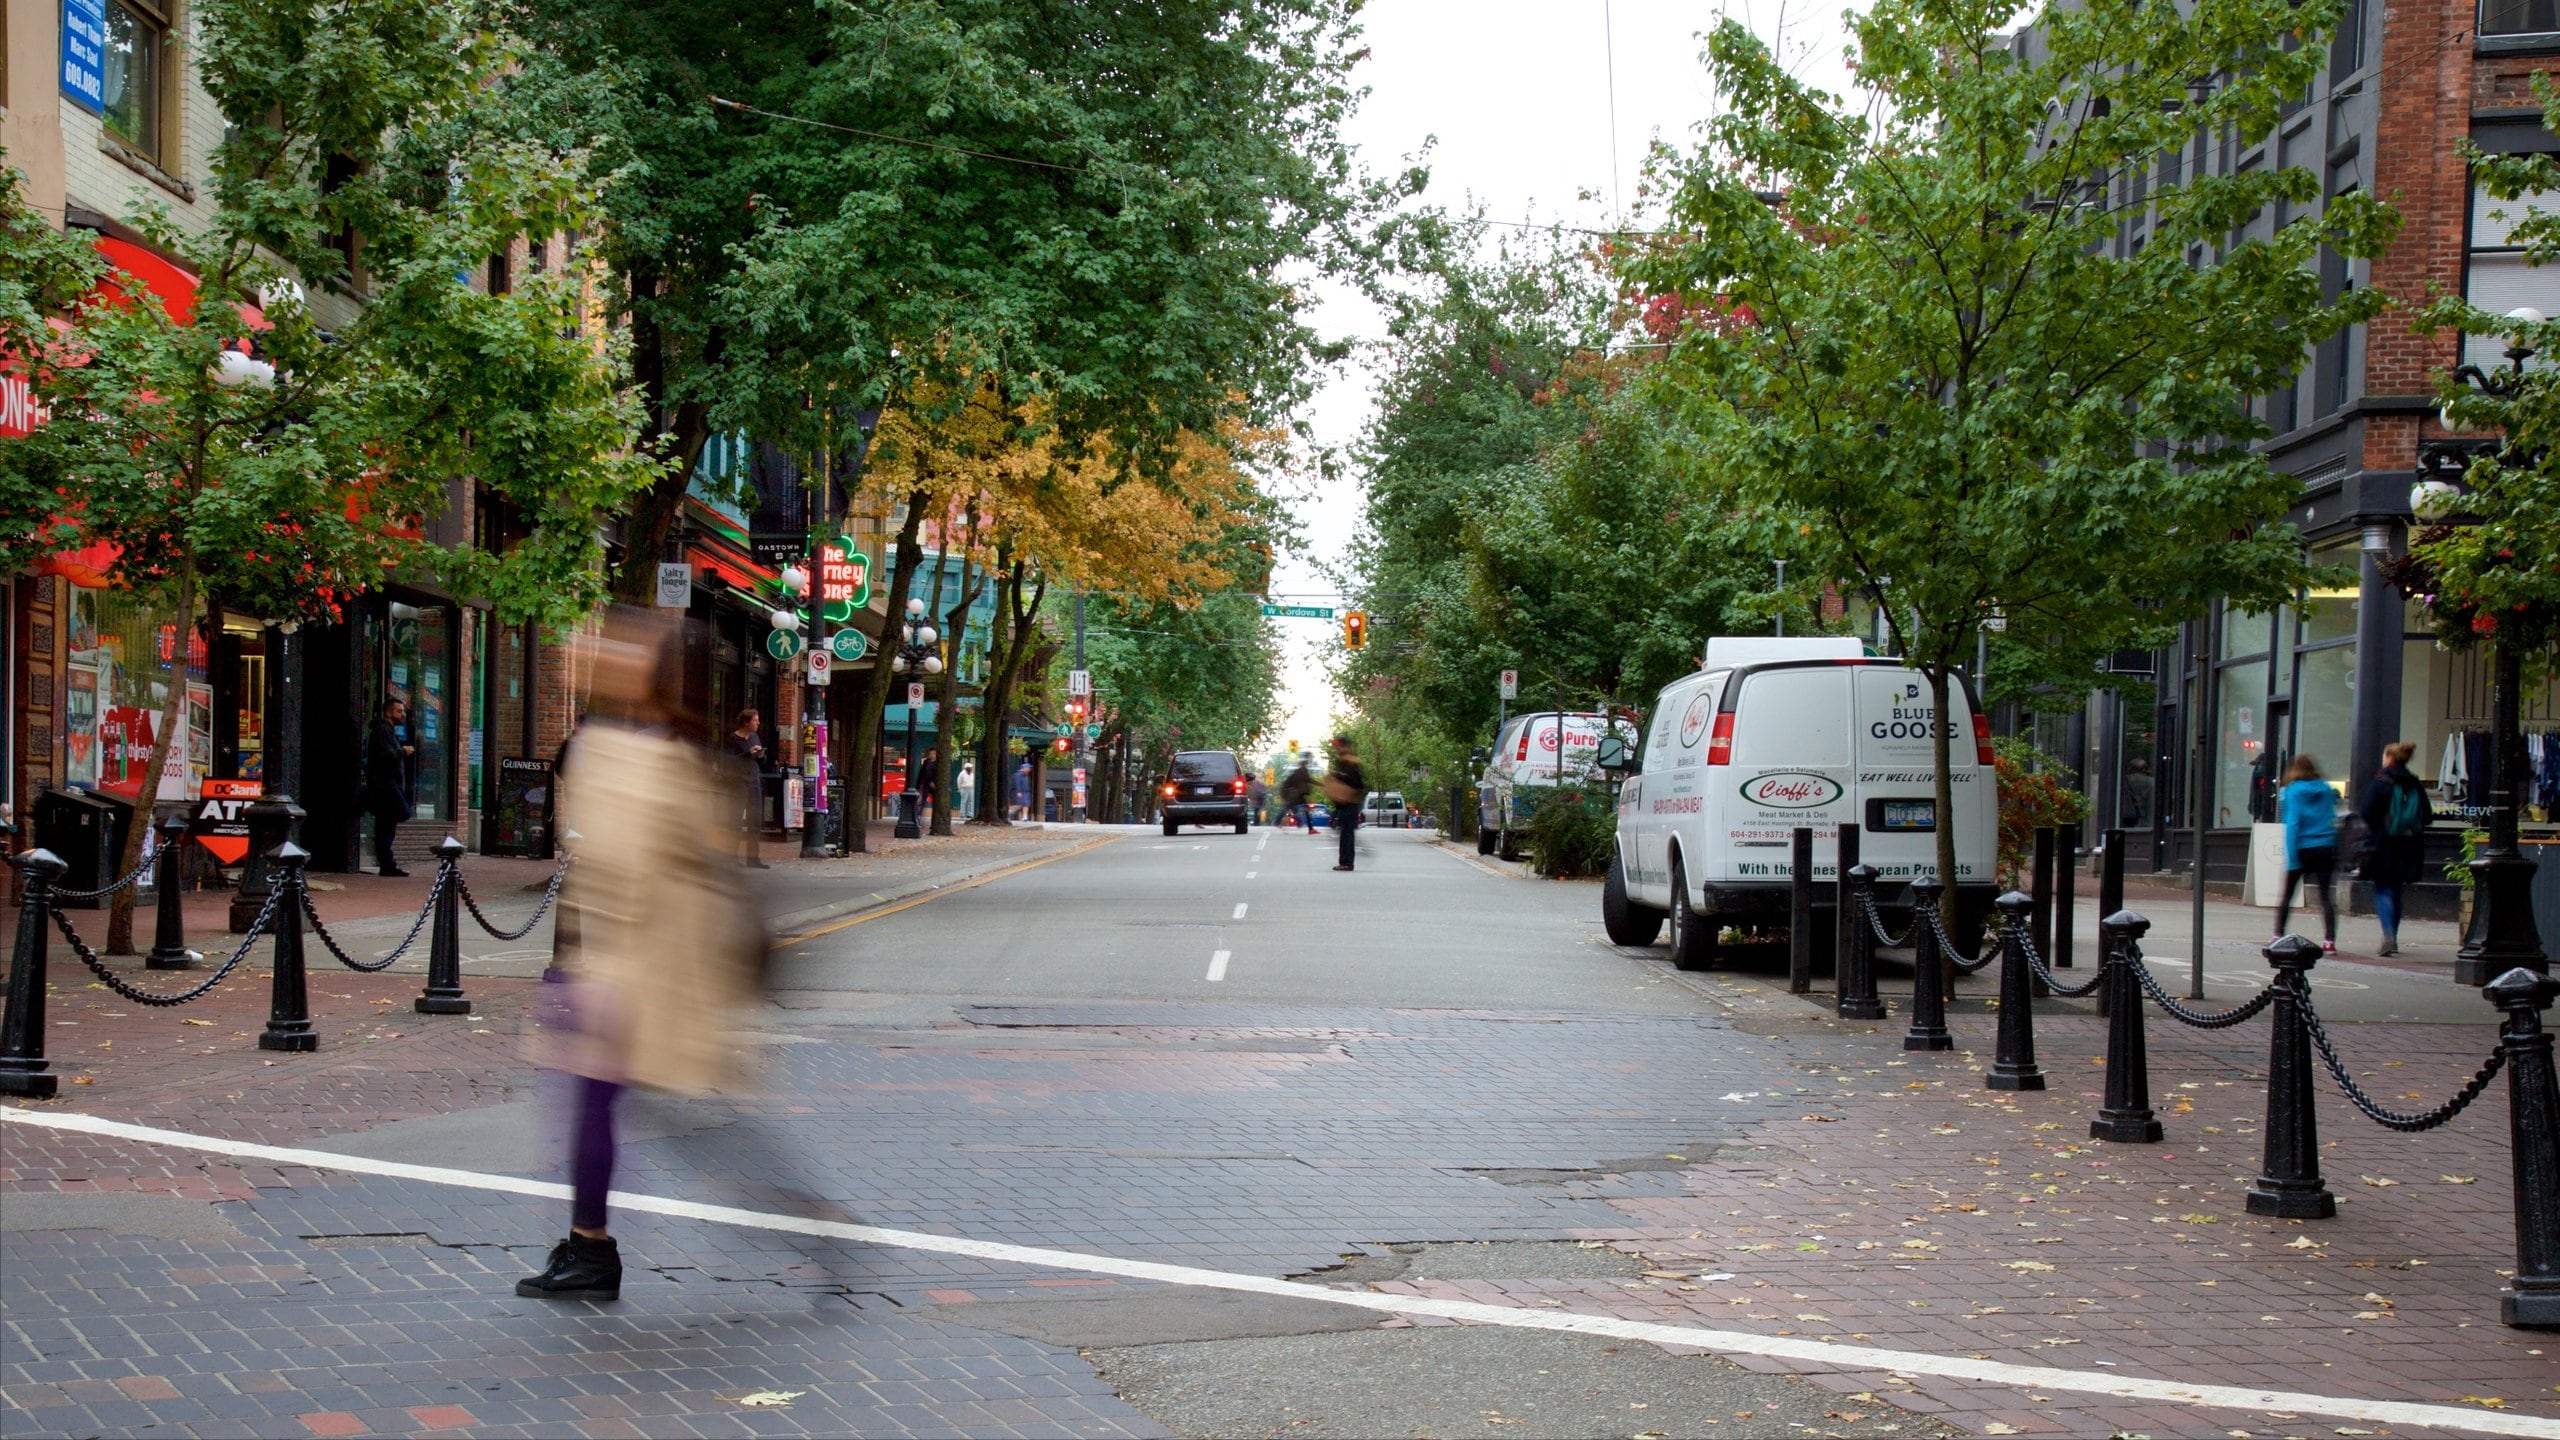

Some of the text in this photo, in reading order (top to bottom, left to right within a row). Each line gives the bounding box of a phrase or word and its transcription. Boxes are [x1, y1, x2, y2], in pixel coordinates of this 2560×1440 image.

[664, 567, 685, 578] Salty
[661, 576, 688, 588] Tongue
[1319, 609, 1329, 617] St
[1893, 708, 1935, 719] BLUE
[163, 762, 183, 778] OODS
[503, 759, 541, 770] GUINNESS
[1885, 773, 1914, 782] WELL
[1916, 773, 1936, 782] LIV
[1759, 780, 1824, 801] Cioffi's
[1738, 863, 1769, 875] With
[1774, 863, 1794, 875] the
[1914, 864, 1972, 875] Procts
